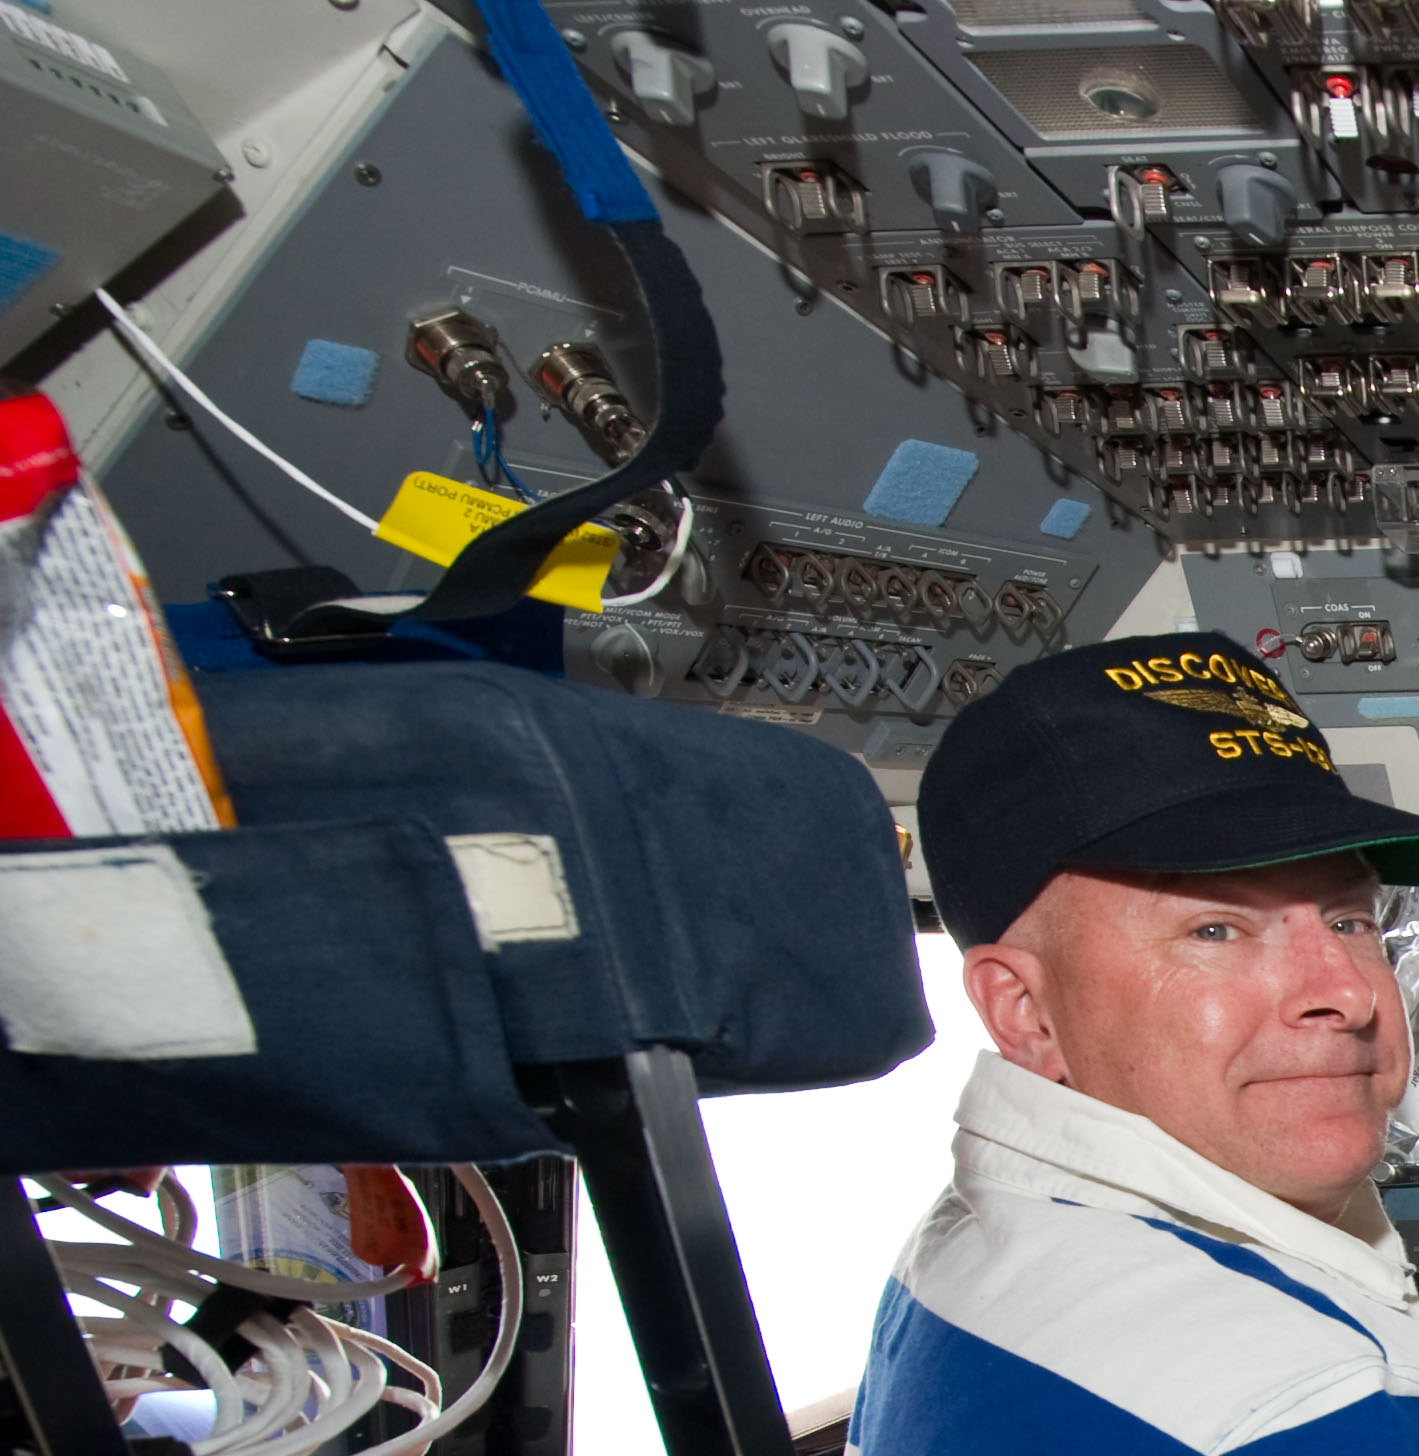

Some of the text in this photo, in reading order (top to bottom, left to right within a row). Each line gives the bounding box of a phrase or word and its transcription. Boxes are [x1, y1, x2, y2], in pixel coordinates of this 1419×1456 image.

[740, 6, 812, 17] OVERHEAD
[743, 135, 777, 146] LEFT
[881, 130, 934, 141] FLOOD
[1335, 224, 1394, 234] PURPOSE
[516, 281, 567, 304] PCMMU
[805, 512, 864, 530] LEFT AUDIO
[606, 606, 653, 618] MIT/ICOM
[1325, 603, 1350, 612] COAS
[1105, 653, 1294, 703] DISCOVER
[1209, 730, 1338, 775] STS-13
[536, 1274, 559, 1283] W2
[448, 1283, 468, 1294] W1
